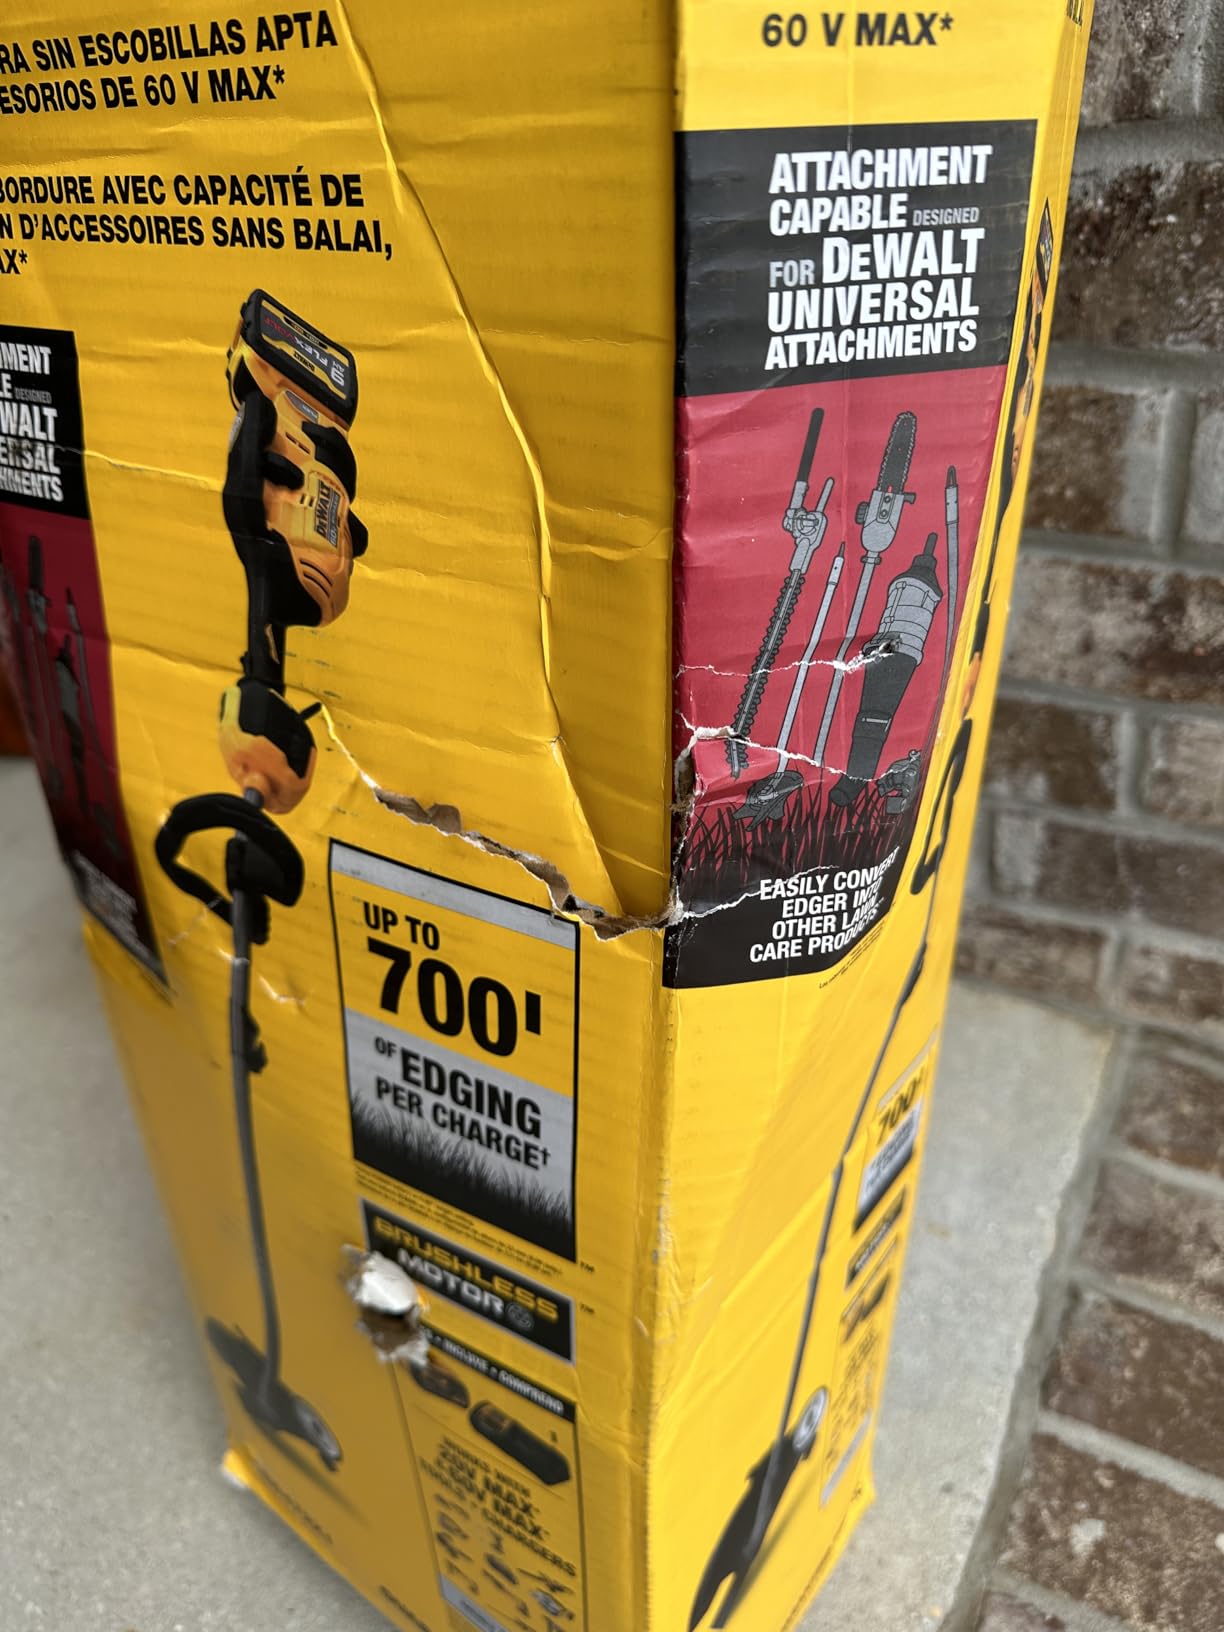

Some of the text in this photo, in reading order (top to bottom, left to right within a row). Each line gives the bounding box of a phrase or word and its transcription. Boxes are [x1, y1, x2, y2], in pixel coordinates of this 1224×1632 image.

[33, 38, 75, 71] SIN
[78, 20, 246, 68] ESCOBILLAS
[257, 11, 338, 52] APTA
[763, 14, 807, 47] 60
[823, 13, 844, 47] V
[0, 73, 96, 114] ESORIOS
[101, 77, 138, 109] DE
[144, 74, 176, 107] 60
[181, 70, 199, 104] V
[103, 175, 166, 206] AVEC
[174, 166, 312, 206] CAPACITÉ
[320, 174, 364, 207] DE
[769, 145, 993, 194] ATTACHMENT
[19, 213, 204, 246] D'ACCESSOIRES
[213, 216, 285, 250] SANS
[294, 219, 392, 261] BALAI,
[769, 193, 980, 236] CAPABLE DESIGNED
[769, 259, 815, 288] FOR
[768, 277, 980, 333] UNIVERSAL
[0, 342, 52, 375] MENT
[764, 319, 978, 371] ATTACHMENTS
[760, 846, 900, 901] EASILY CONVERT
[782, 876, 883, 919] EDGER INTO
[363, 901, 440, 951] UP TO
[750, 939, 803, 963] CARE
[807, 903, 880, 956] PRODUCTS
[772, 914, 837, 940] OTHER
[367, 936, 541, 1057] 700'
[375, 1037, 541, 1139] OF EDGING
[376, 1077, 423, 1118] PER
[373, 1215, 559, 1324] BRUSHLESS
[397, 1247, 505, 1316] MOTOR
